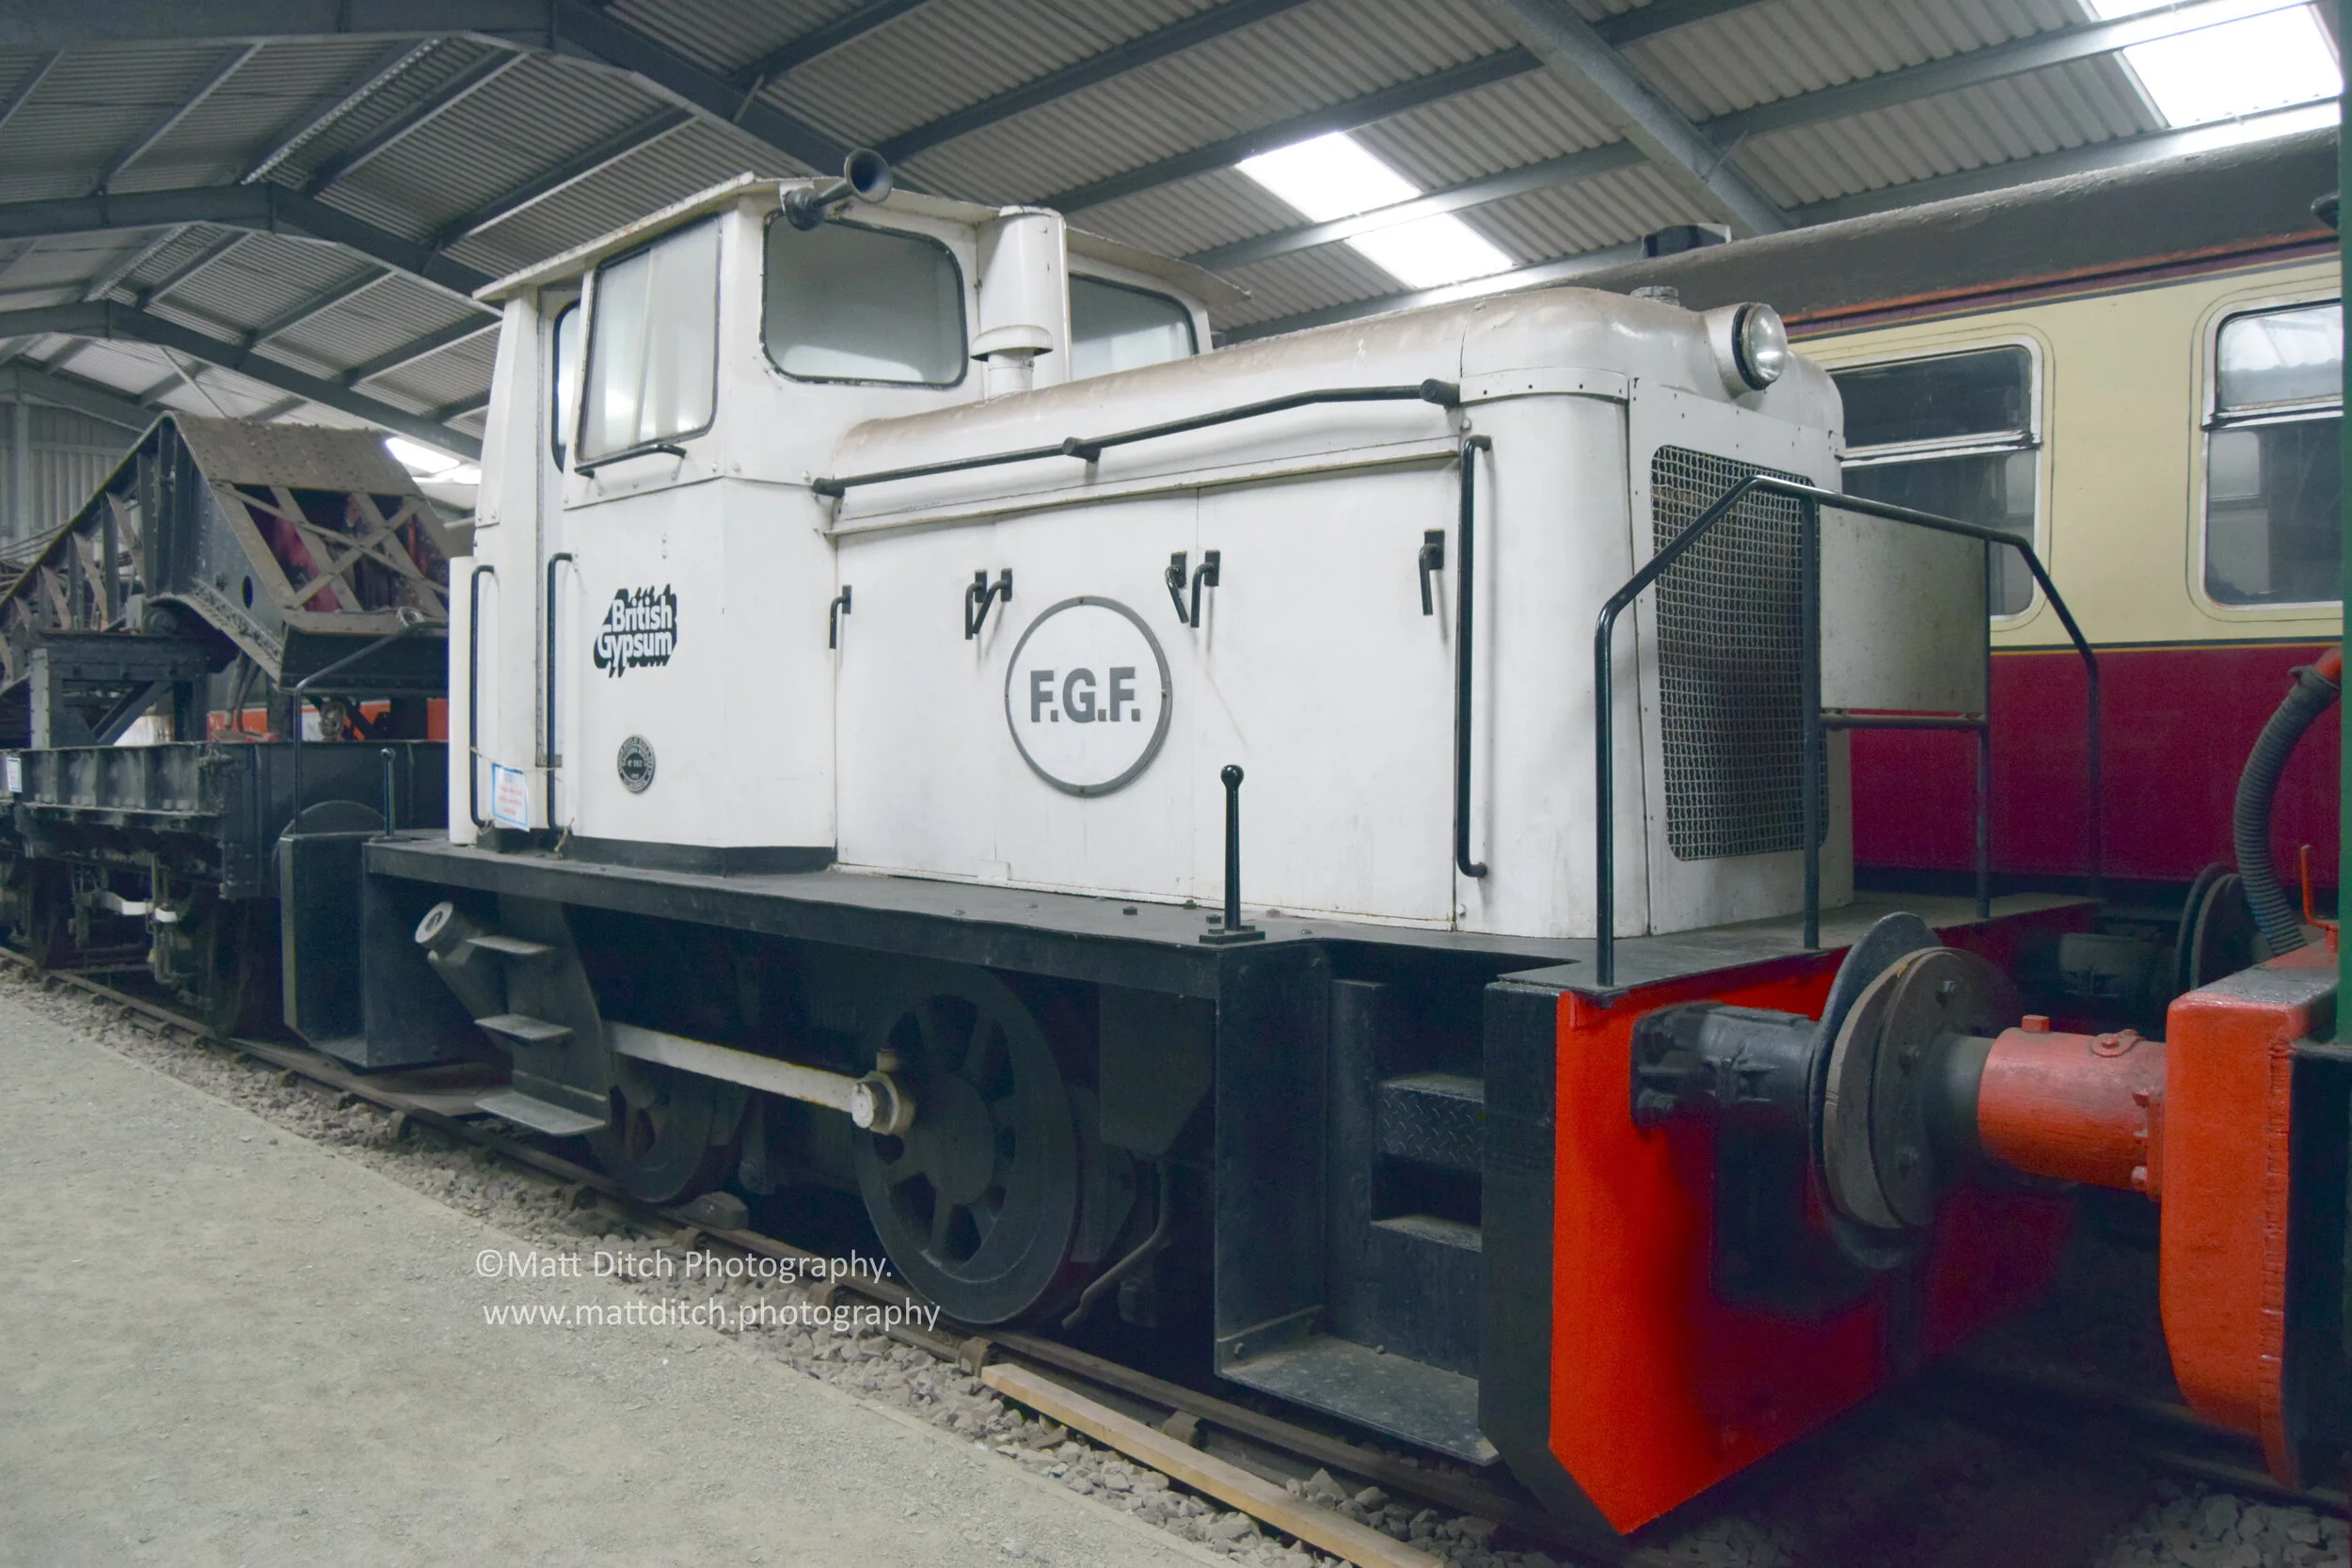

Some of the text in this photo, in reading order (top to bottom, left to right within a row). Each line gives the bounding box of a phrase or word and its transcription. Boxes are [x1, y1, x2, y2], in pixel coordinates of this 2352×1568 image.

[612, 594, 674, 632] British
[597, 625, 674, 668] Gypsum
[1030, 666, 1141, 723] F.G.F.
